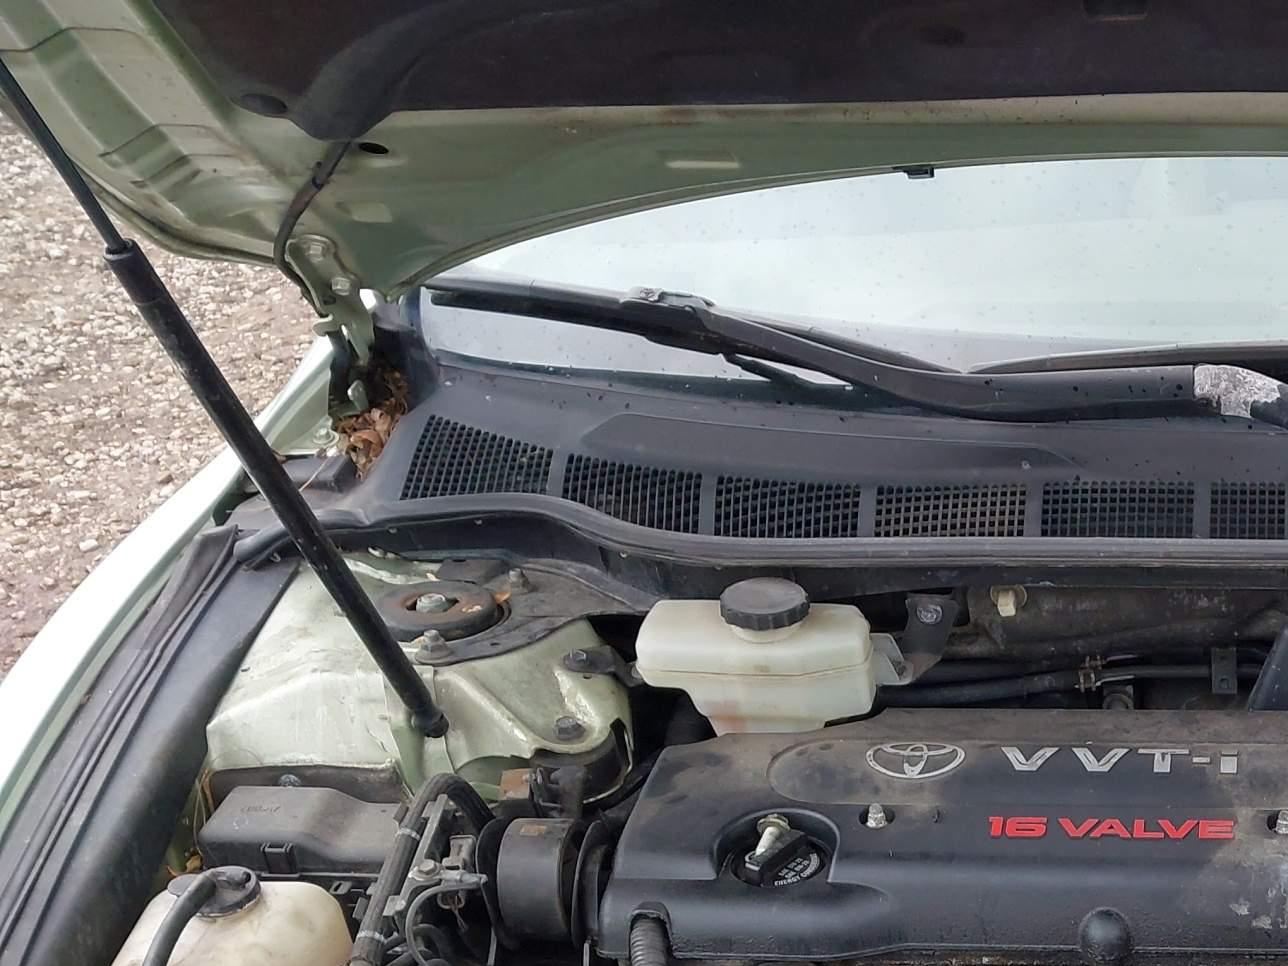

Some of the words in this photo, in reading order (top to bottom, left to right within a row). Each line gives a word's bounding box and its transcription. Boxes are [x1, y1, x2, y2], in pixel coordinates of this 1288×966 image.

[1001, 746, 1239, 774] VVT-i
[988, 816, 1048, 839] 16
[1058, 818, 1236, 840] VALVE
